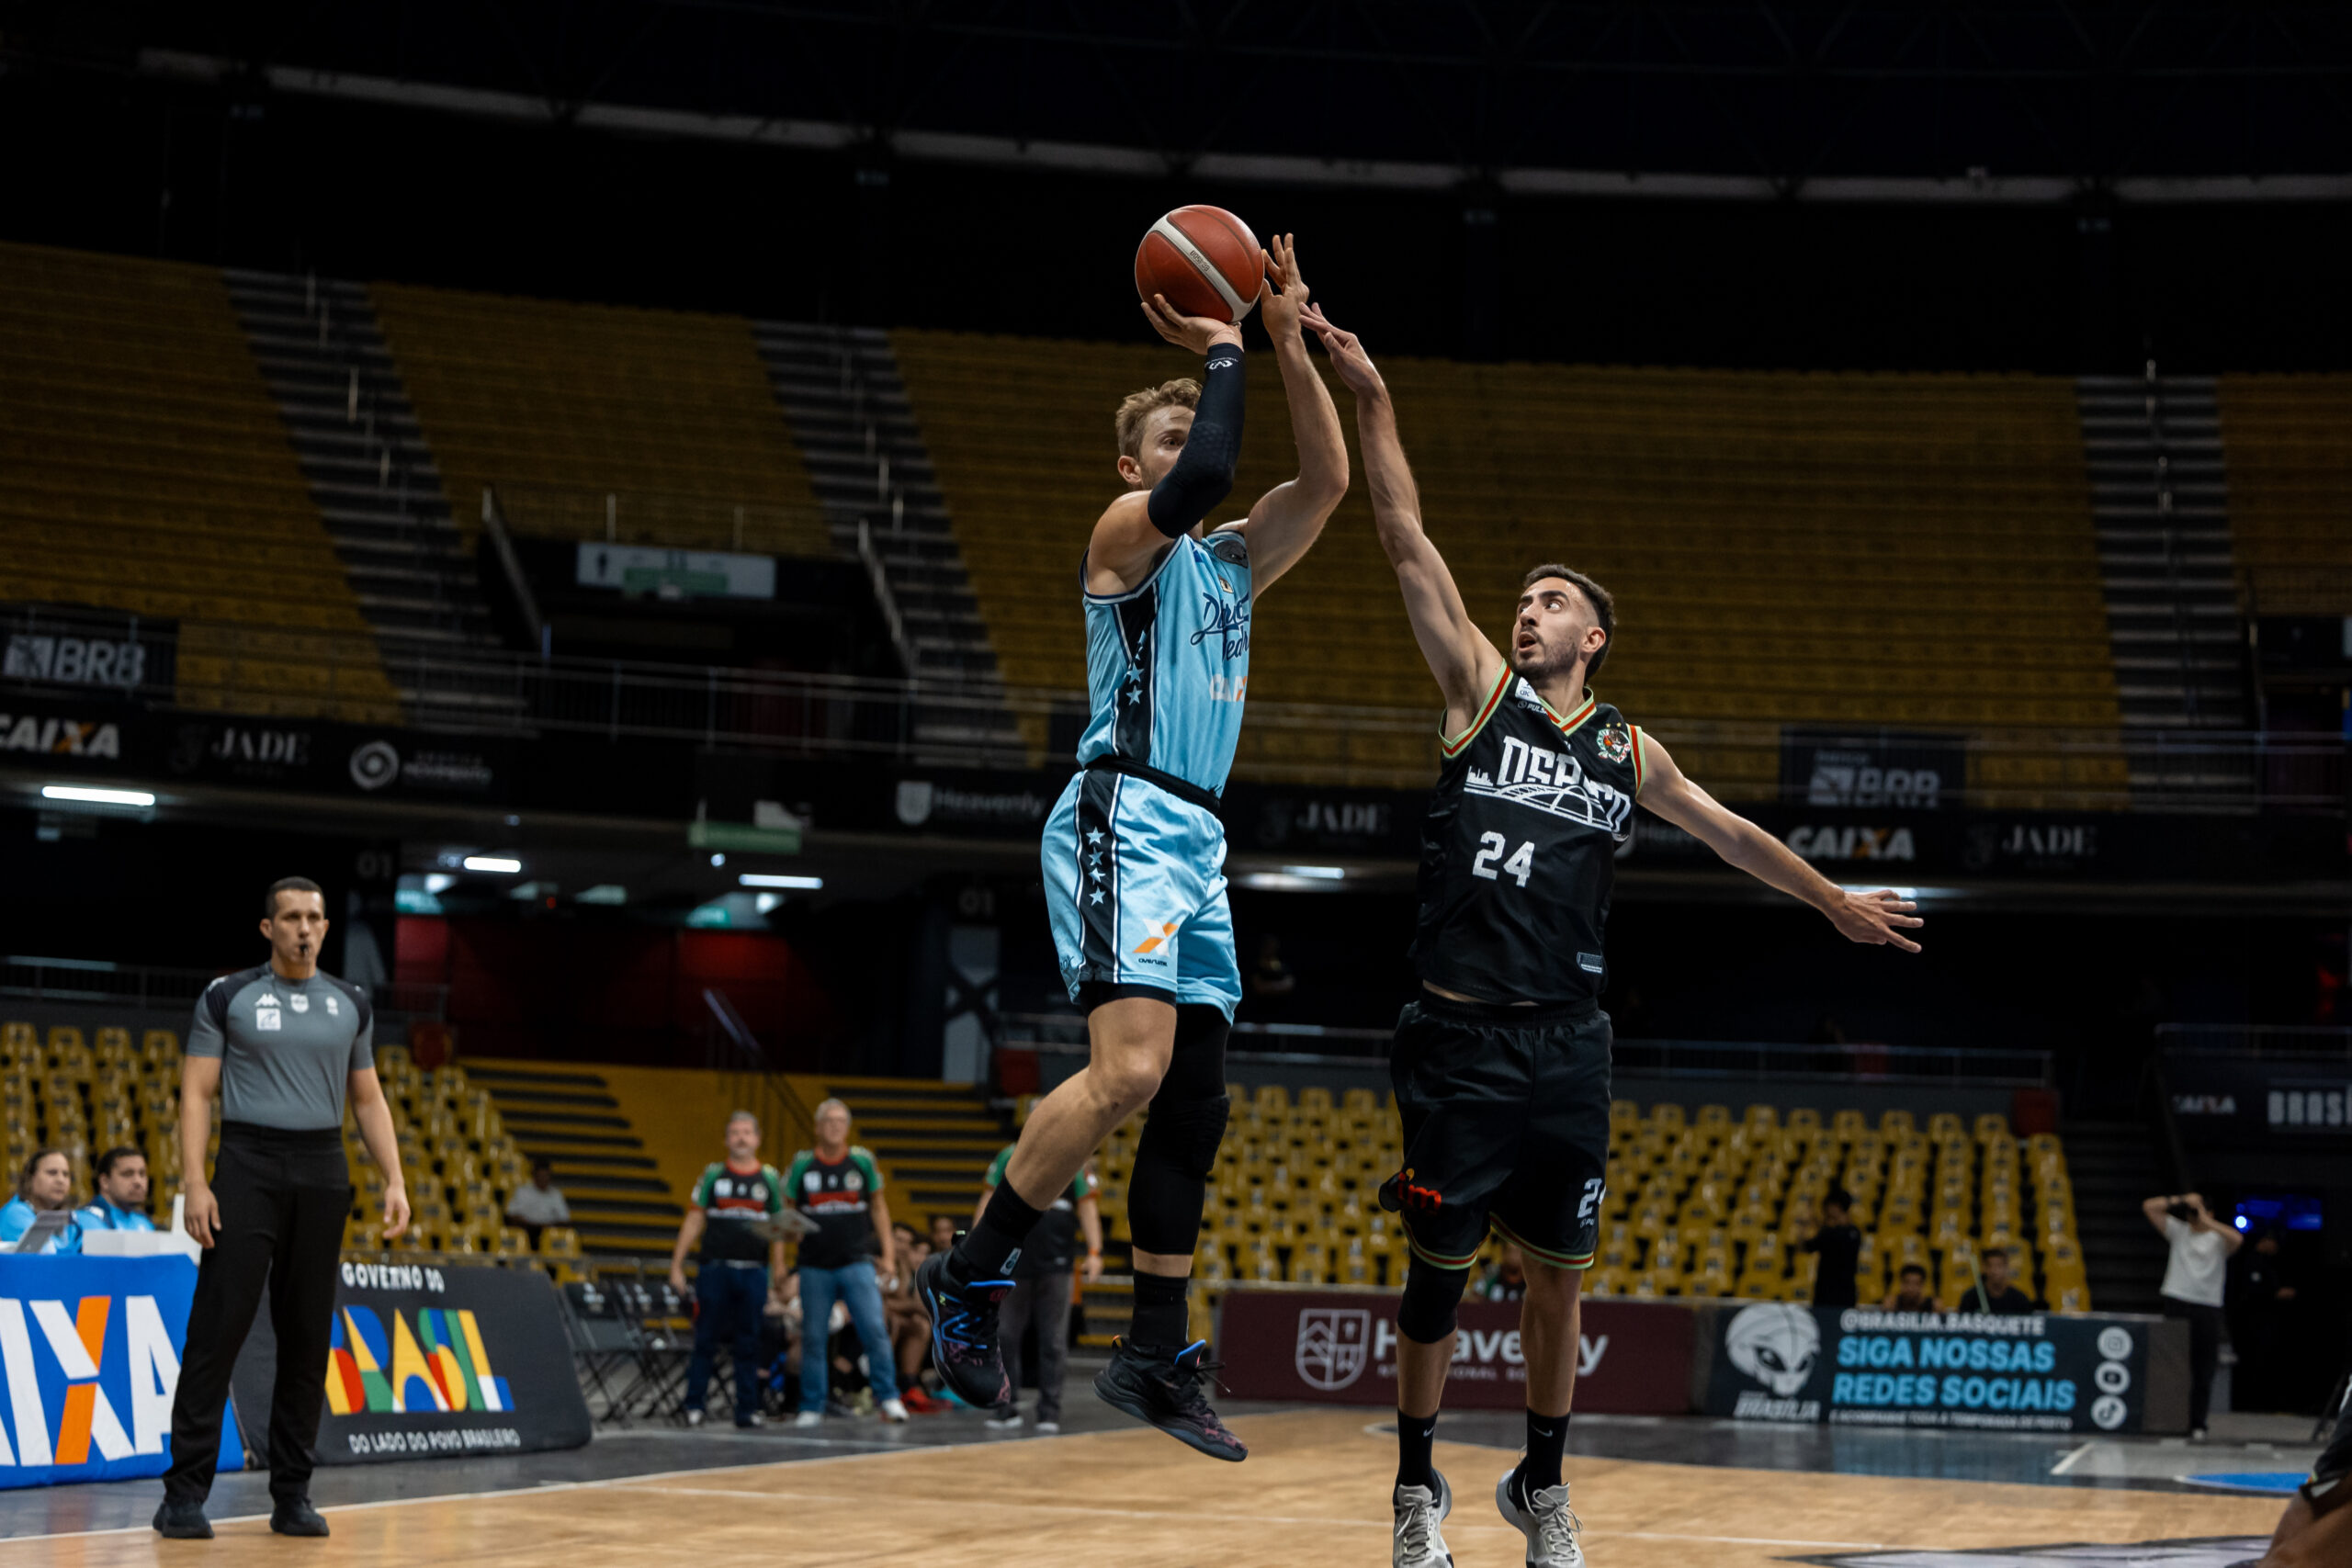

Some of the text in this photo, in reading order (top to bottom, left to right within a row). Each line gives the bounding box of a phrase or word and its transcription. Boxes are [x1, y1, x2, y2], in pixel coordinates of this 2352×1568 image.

[52, 637, 146, 687] BRB
[210, 727, 311, 766] JADE
[1295, 800, 1392, 835] JADE
[1472, 830, 1535, 888] 24
[1787, 825, 1917, 862] CAIXA
[2002, 823, 2098, 857] JADE
[342, 1261, 424, 1290] GOVERNO
[324, 1304, 516, 1416] BRASIL
[1374, 1317, 1609, 1377] Havey
[1837, 1335, 2056, 1373] SIGA NOSSAS
[1831, 1371, 2077, 1413] REDES SOCIAIS
[348, 1434, 370, 1454] DO
[370, 1431, 407, 1453] LADO
[406, 1431, 429, 1451] DO
[427, 1429, 463, 1451] POVO
